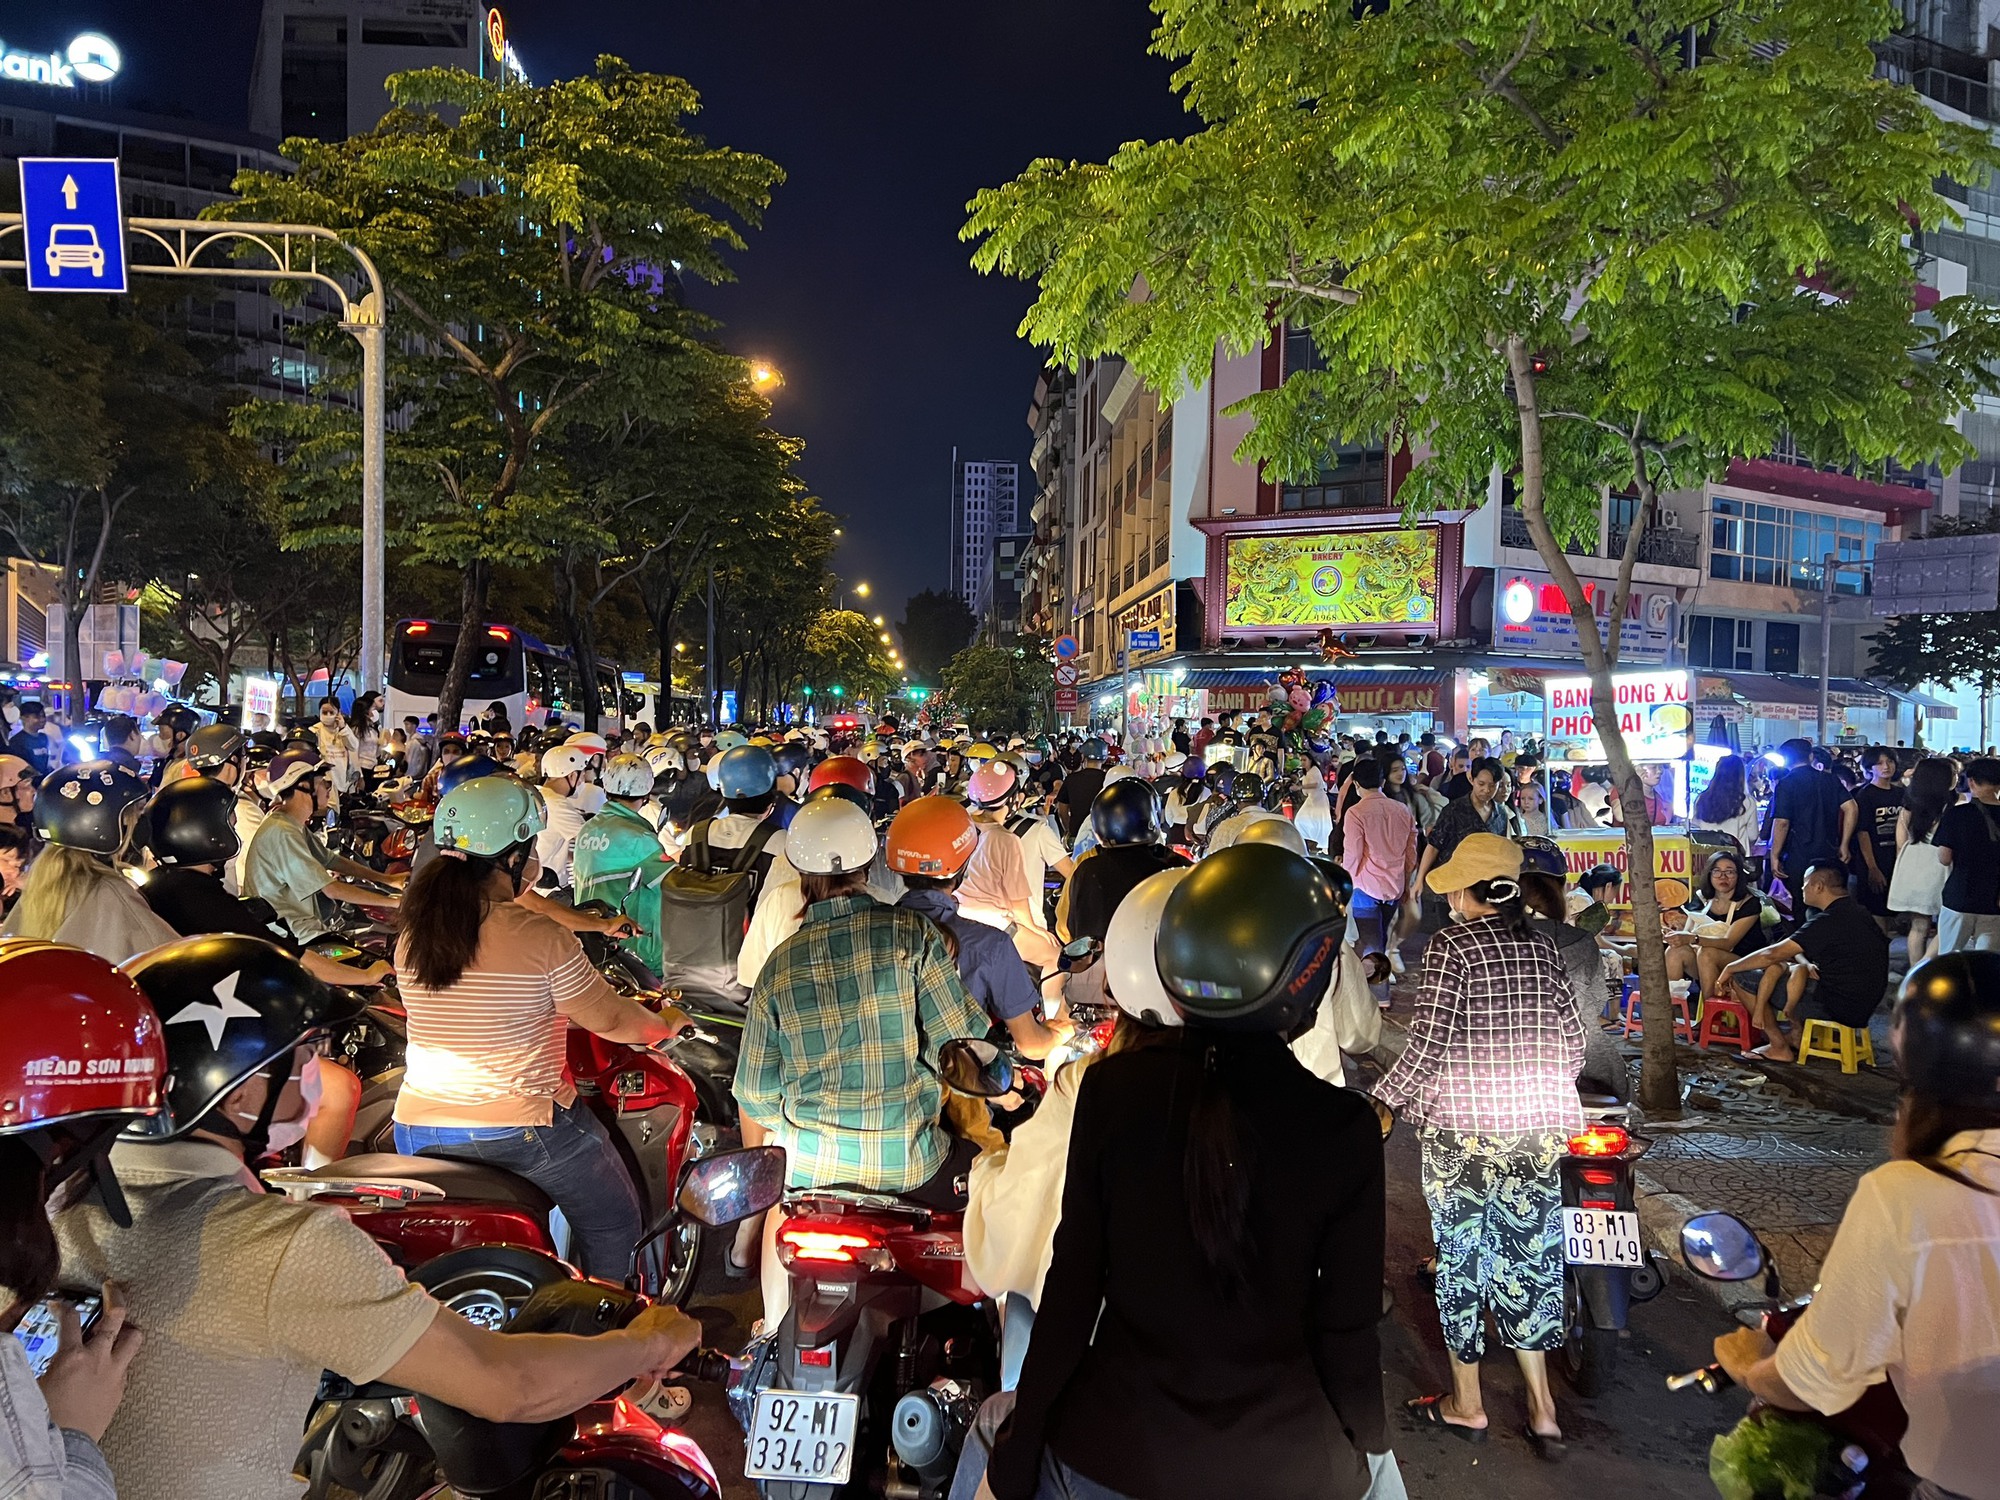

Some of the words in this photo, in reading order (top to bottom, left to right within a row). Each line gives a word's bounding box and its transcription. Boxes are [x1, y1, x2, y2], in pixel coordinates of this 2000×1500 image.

[0, 46, 75, 87] ank
[1311, 552, 1345, 561] BAKERY
[1314, 604, 1339, 612] SINCE
[1595, 588, 1642, 620] LN
[1314, 613, 1338, 622] 1968
[1208, 689, 1245, 710] BÁNH
[1337, 687, 1385, 711] NHƯ
[1386, 689, 1434, 710] LAN
[1663, 681, 1689, 702] XU
[1551, 710, 1593, 737] PHÔ
[1617, 712, 1641, 734] AI
[579, 833, 610, 852] Grab
[1564, 846, 1598, 874] ÁNH
[1660, 850, 1685, 873] XU
[1287, 936, 1334, 996] HONDA
[26, 1058, 81, 1076] HEAD
[86, 1058, 121, 1075] SƠN
[1573, 1212, 1627, 1237] 83-M1
[1569, 1237, 1639, 1262] 091.49
[817, 1283, 849, 1293] HONDA
[769, 1398, 840, 1436] 92-M1
